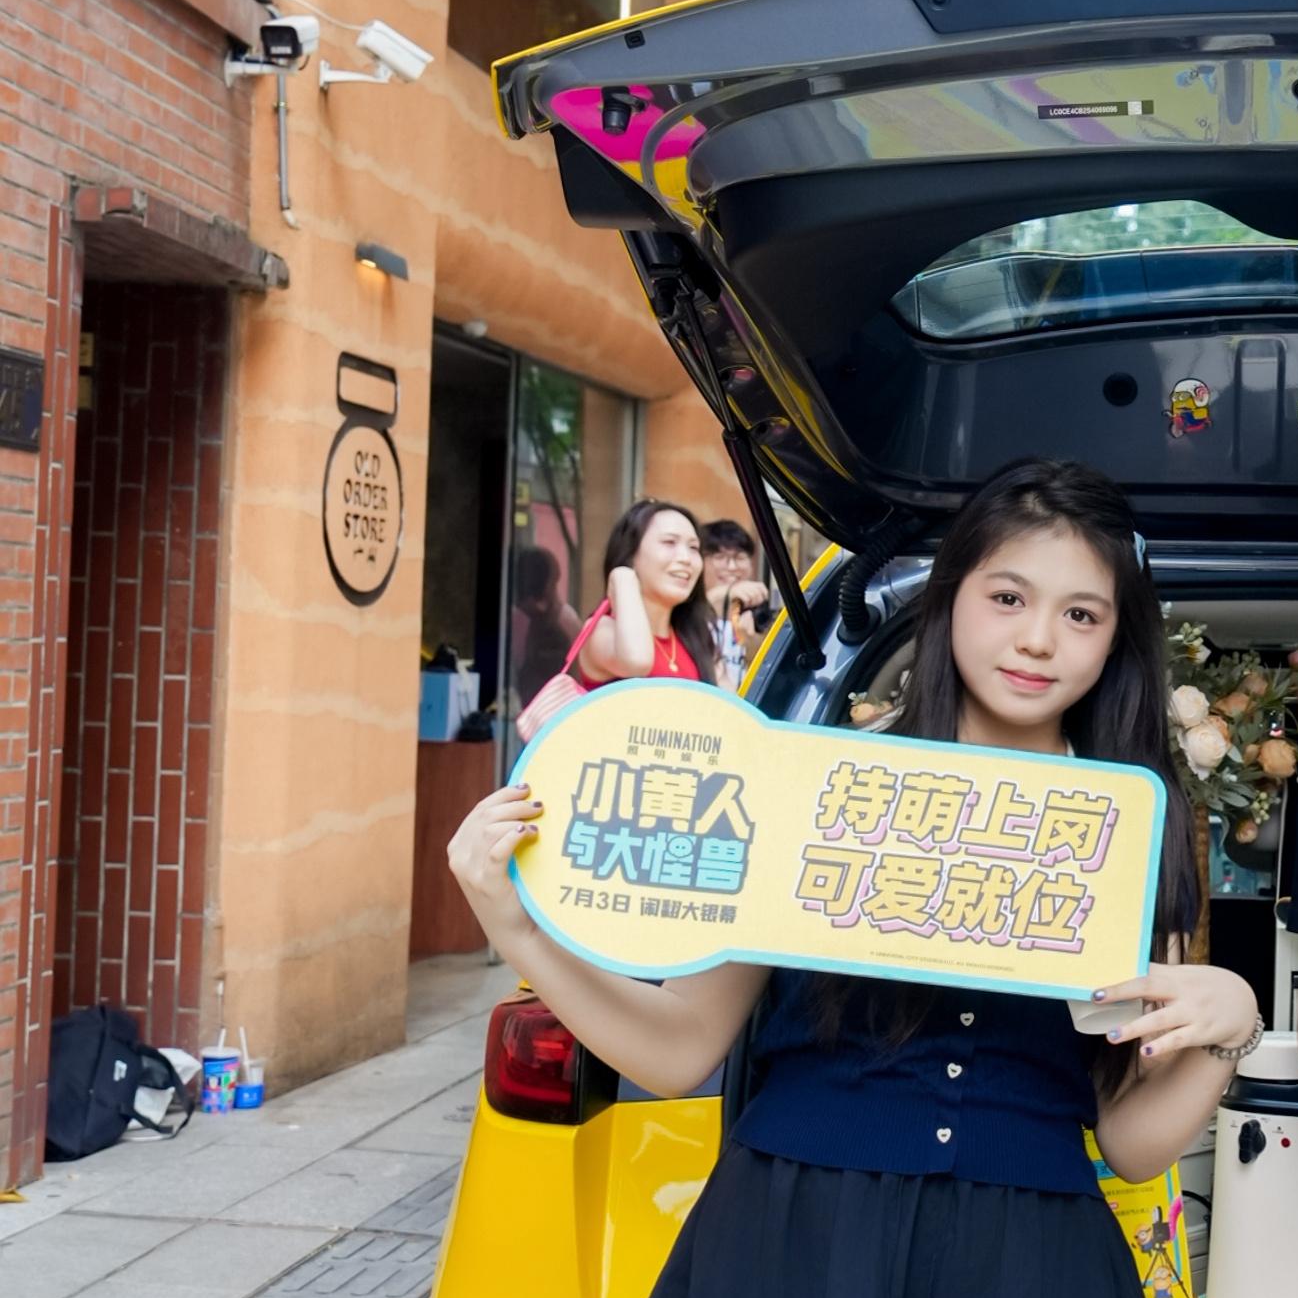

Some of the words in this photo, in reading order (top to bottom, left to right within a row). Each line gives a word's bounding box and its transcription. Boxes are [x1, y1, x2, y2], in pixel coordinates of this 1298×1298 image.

[354, 451, 381, 479] OLD
[343, 479, 388, 510] ORDER
[343, 512, 387, 544] STORE
[628, 725, 722, 756] ILLUMINATION
[573, 759, 754, 841] 小黄人
[815, 761, 1115, 864] 持萌上岗
[565, 819, 748, 893] 与大怪兽
[559, 885, 631, 914] 7月3日
[640, 896, 738, 924] 闹翻大银幕
[795, 844, 1090, 946] 可爱就位
